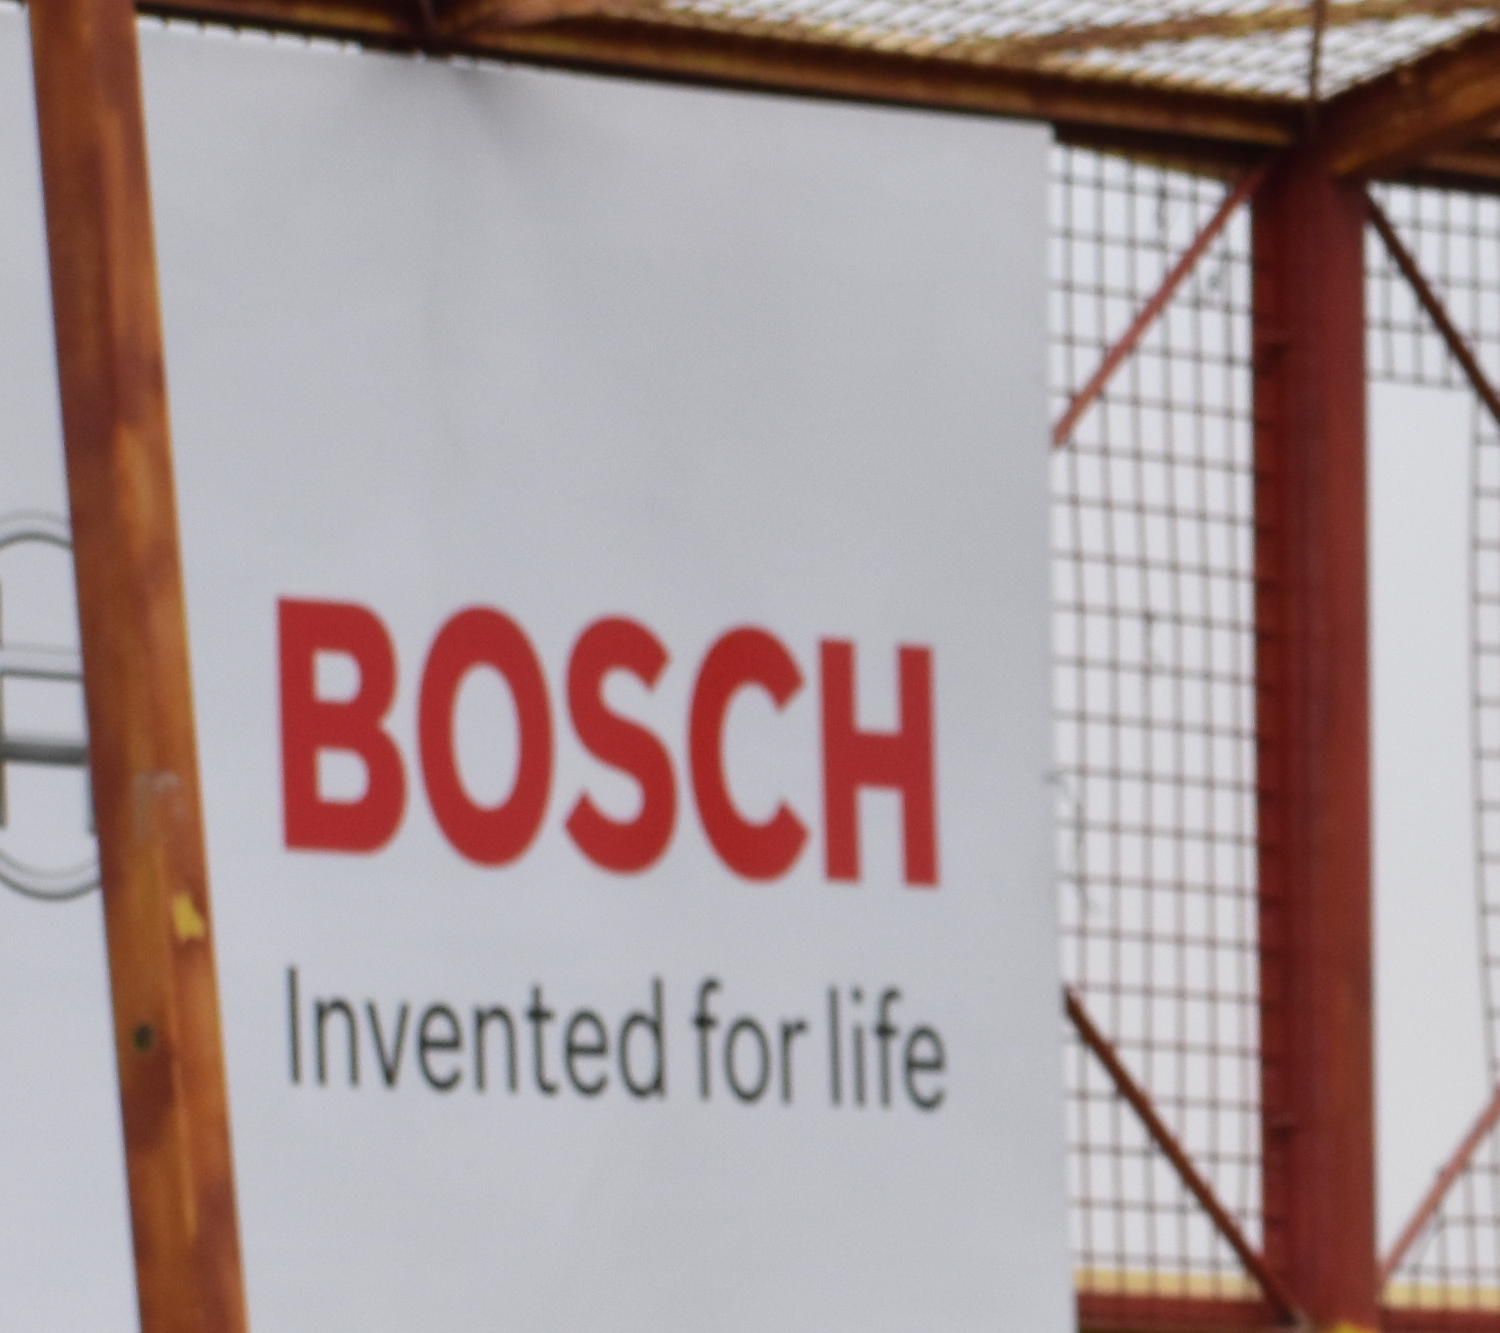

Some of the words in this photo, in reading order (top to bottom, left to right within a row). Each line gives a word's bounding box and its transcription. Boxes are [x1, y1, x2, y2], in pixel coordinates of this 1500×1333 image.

[276, 595, 940, 888] BOSCH
[286, 964, 667, 1101] Invented
[693, 976, 808, 1108] for
[825, 985, 948, 1114] life
